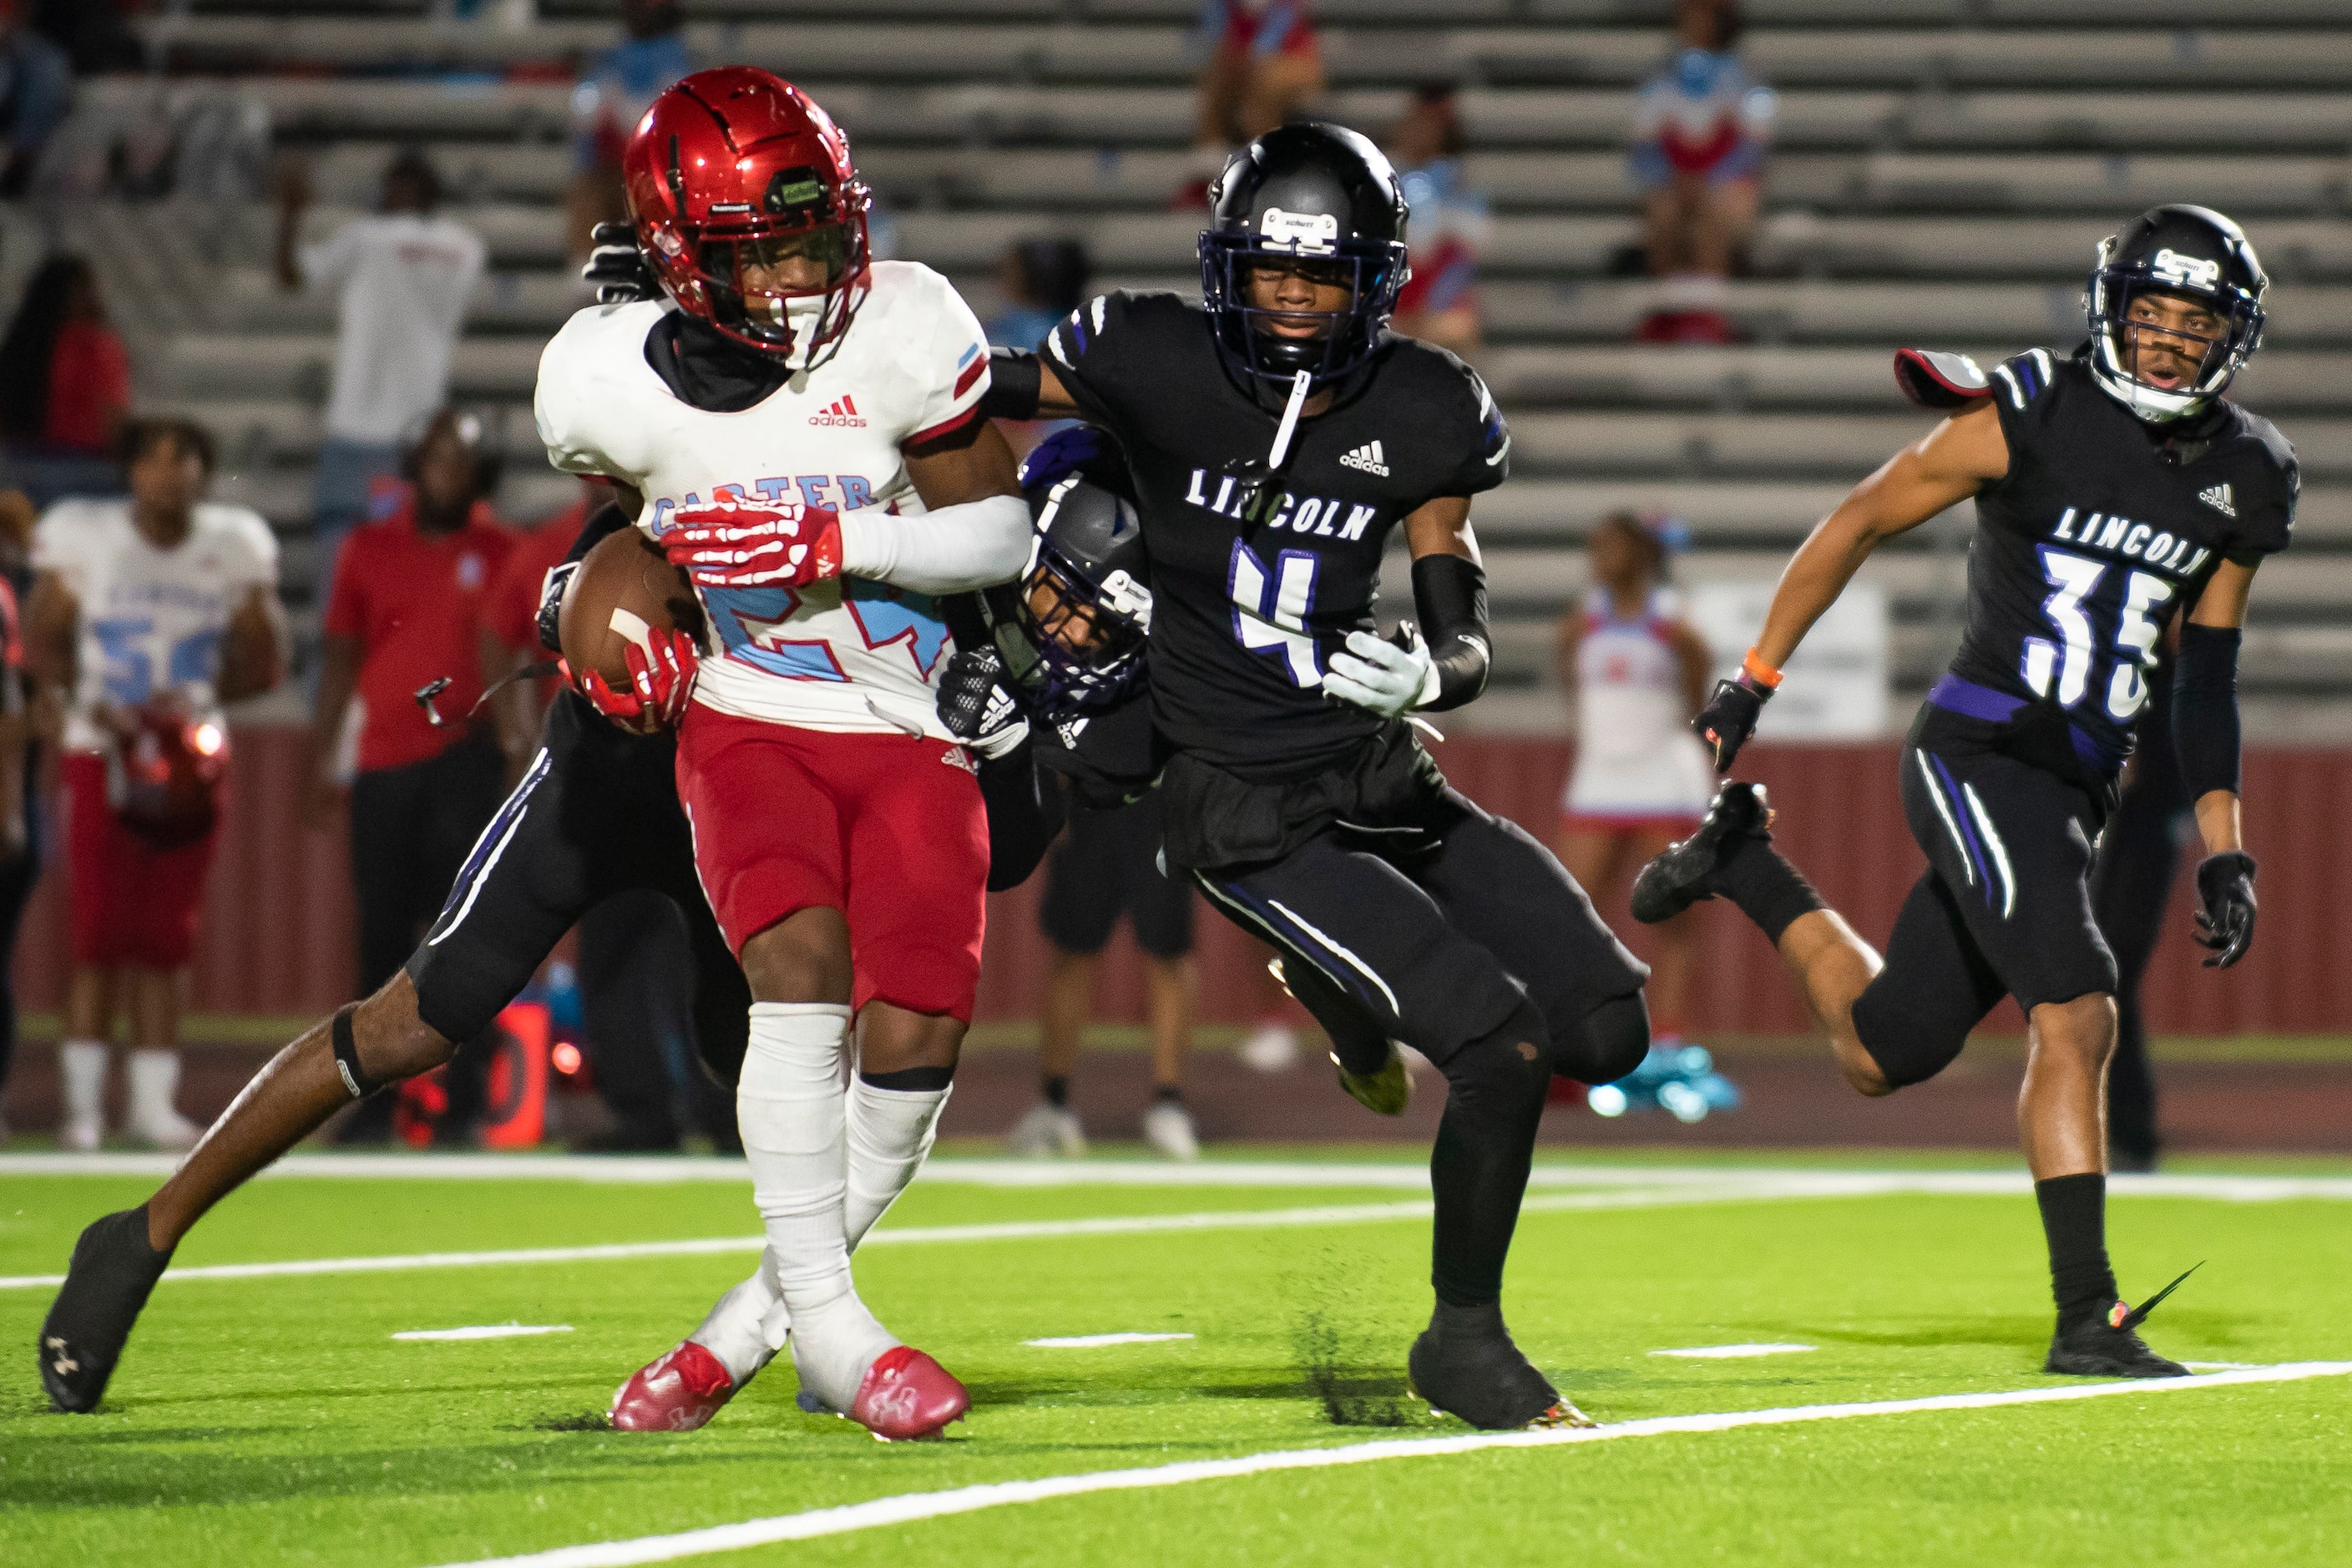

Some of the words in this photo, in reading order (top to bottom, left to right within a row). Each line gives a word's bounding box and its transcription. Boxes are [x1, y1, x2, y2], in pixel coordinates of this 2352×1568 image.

[808, 414, 867, 428] adidas
[1339, 453, 1390, 478] adidas
[2198, 491, 2238, 518] adidas
[2051, 506, 2213, 576] LINCOLN
[1227, 535, 1325, 690] 4
[2019, 542, 2177, 725] 35
